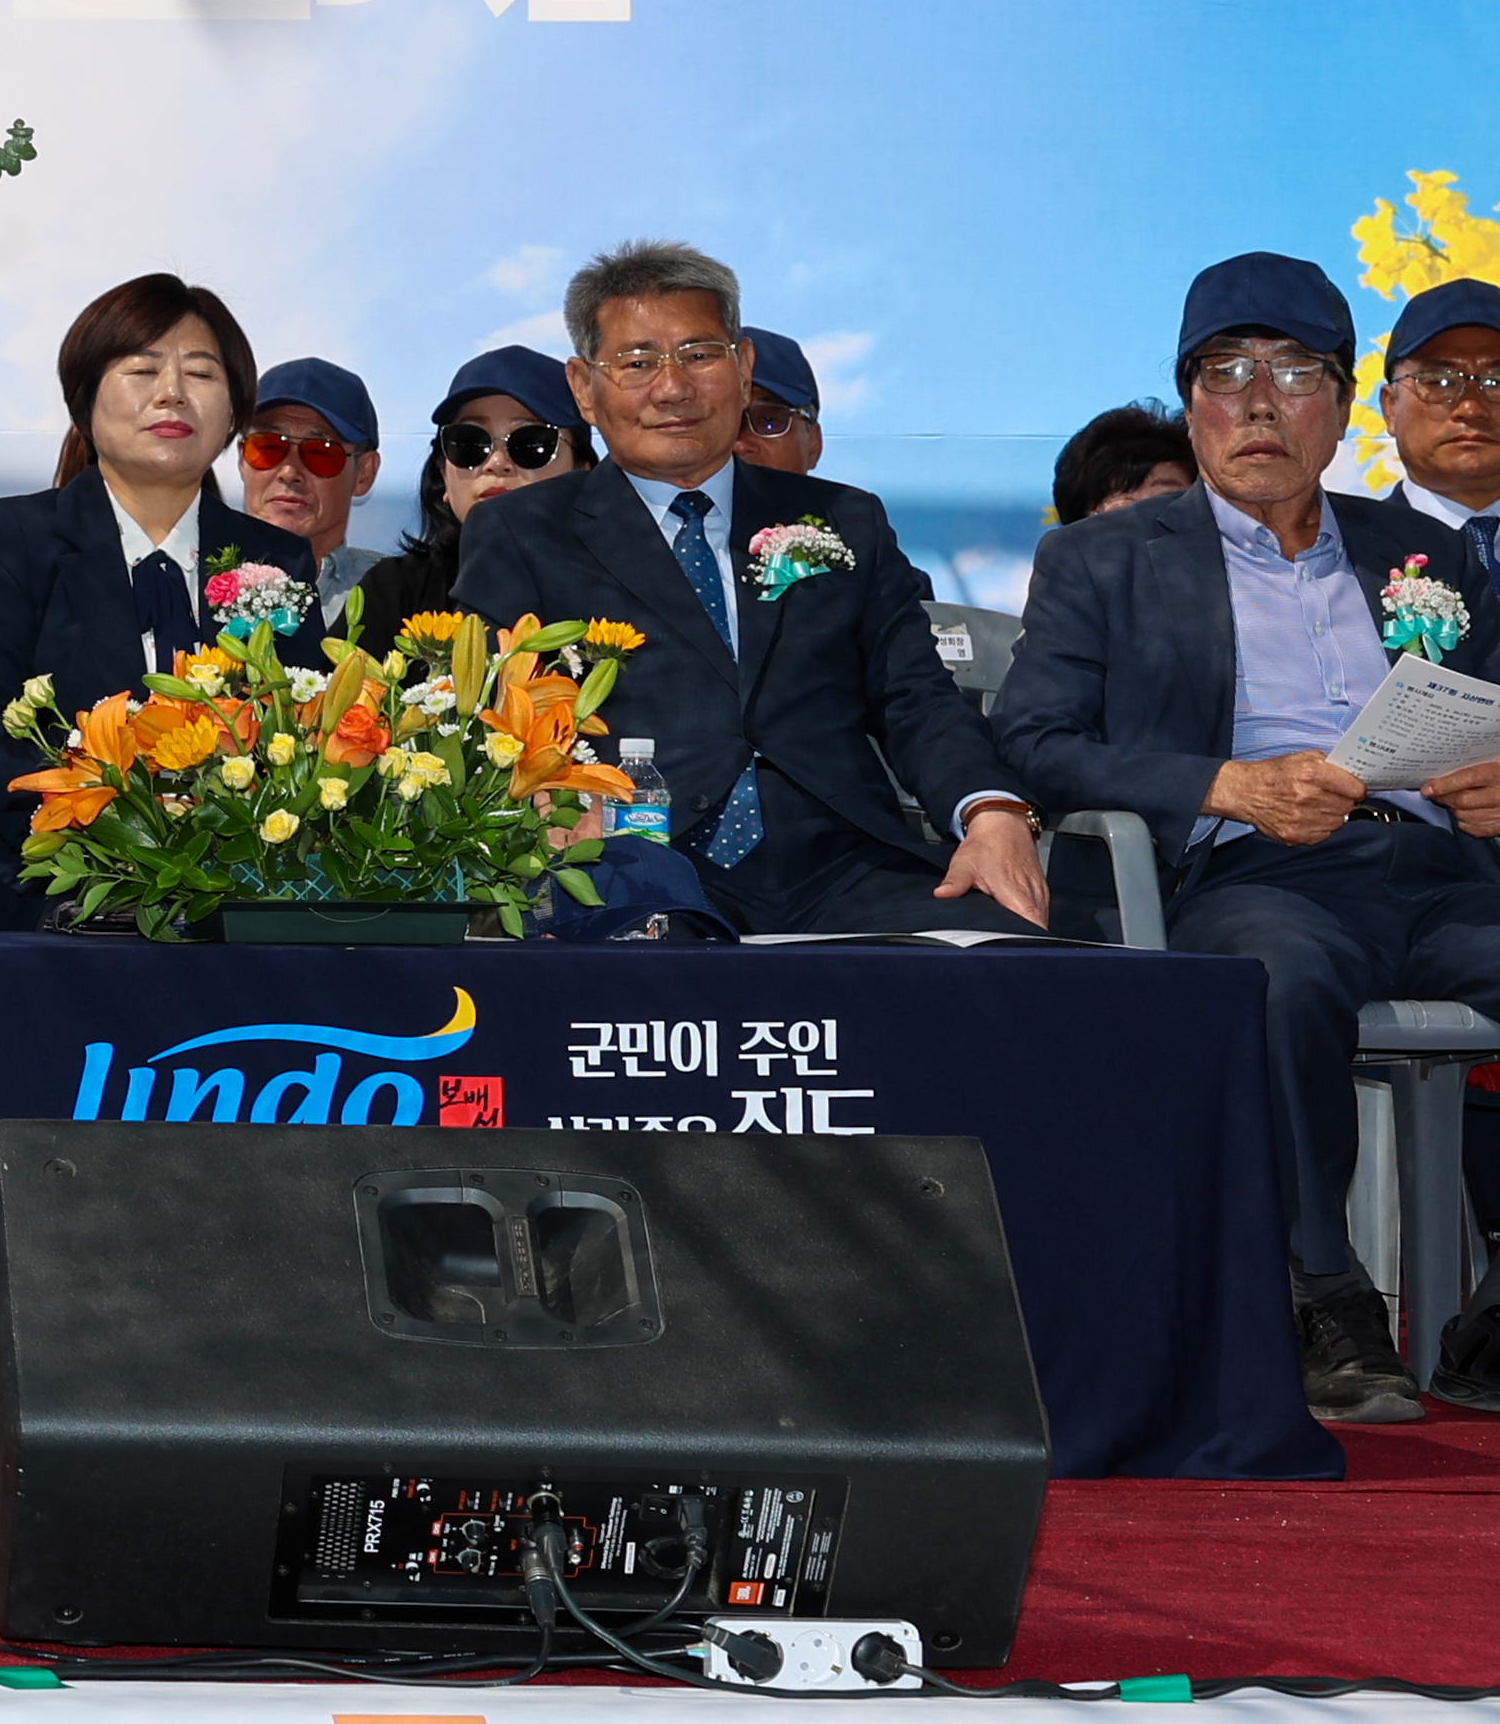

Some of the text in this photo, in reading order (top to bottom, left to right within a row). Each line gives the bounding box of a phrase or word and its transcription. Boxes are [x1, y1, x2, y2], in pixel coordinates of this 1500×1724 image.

[566, 1019, 839, 1080] 군민이 주인
[363, 1499, 386, 1554] PRX715
[736, 1586, 751, 1601] JBL
